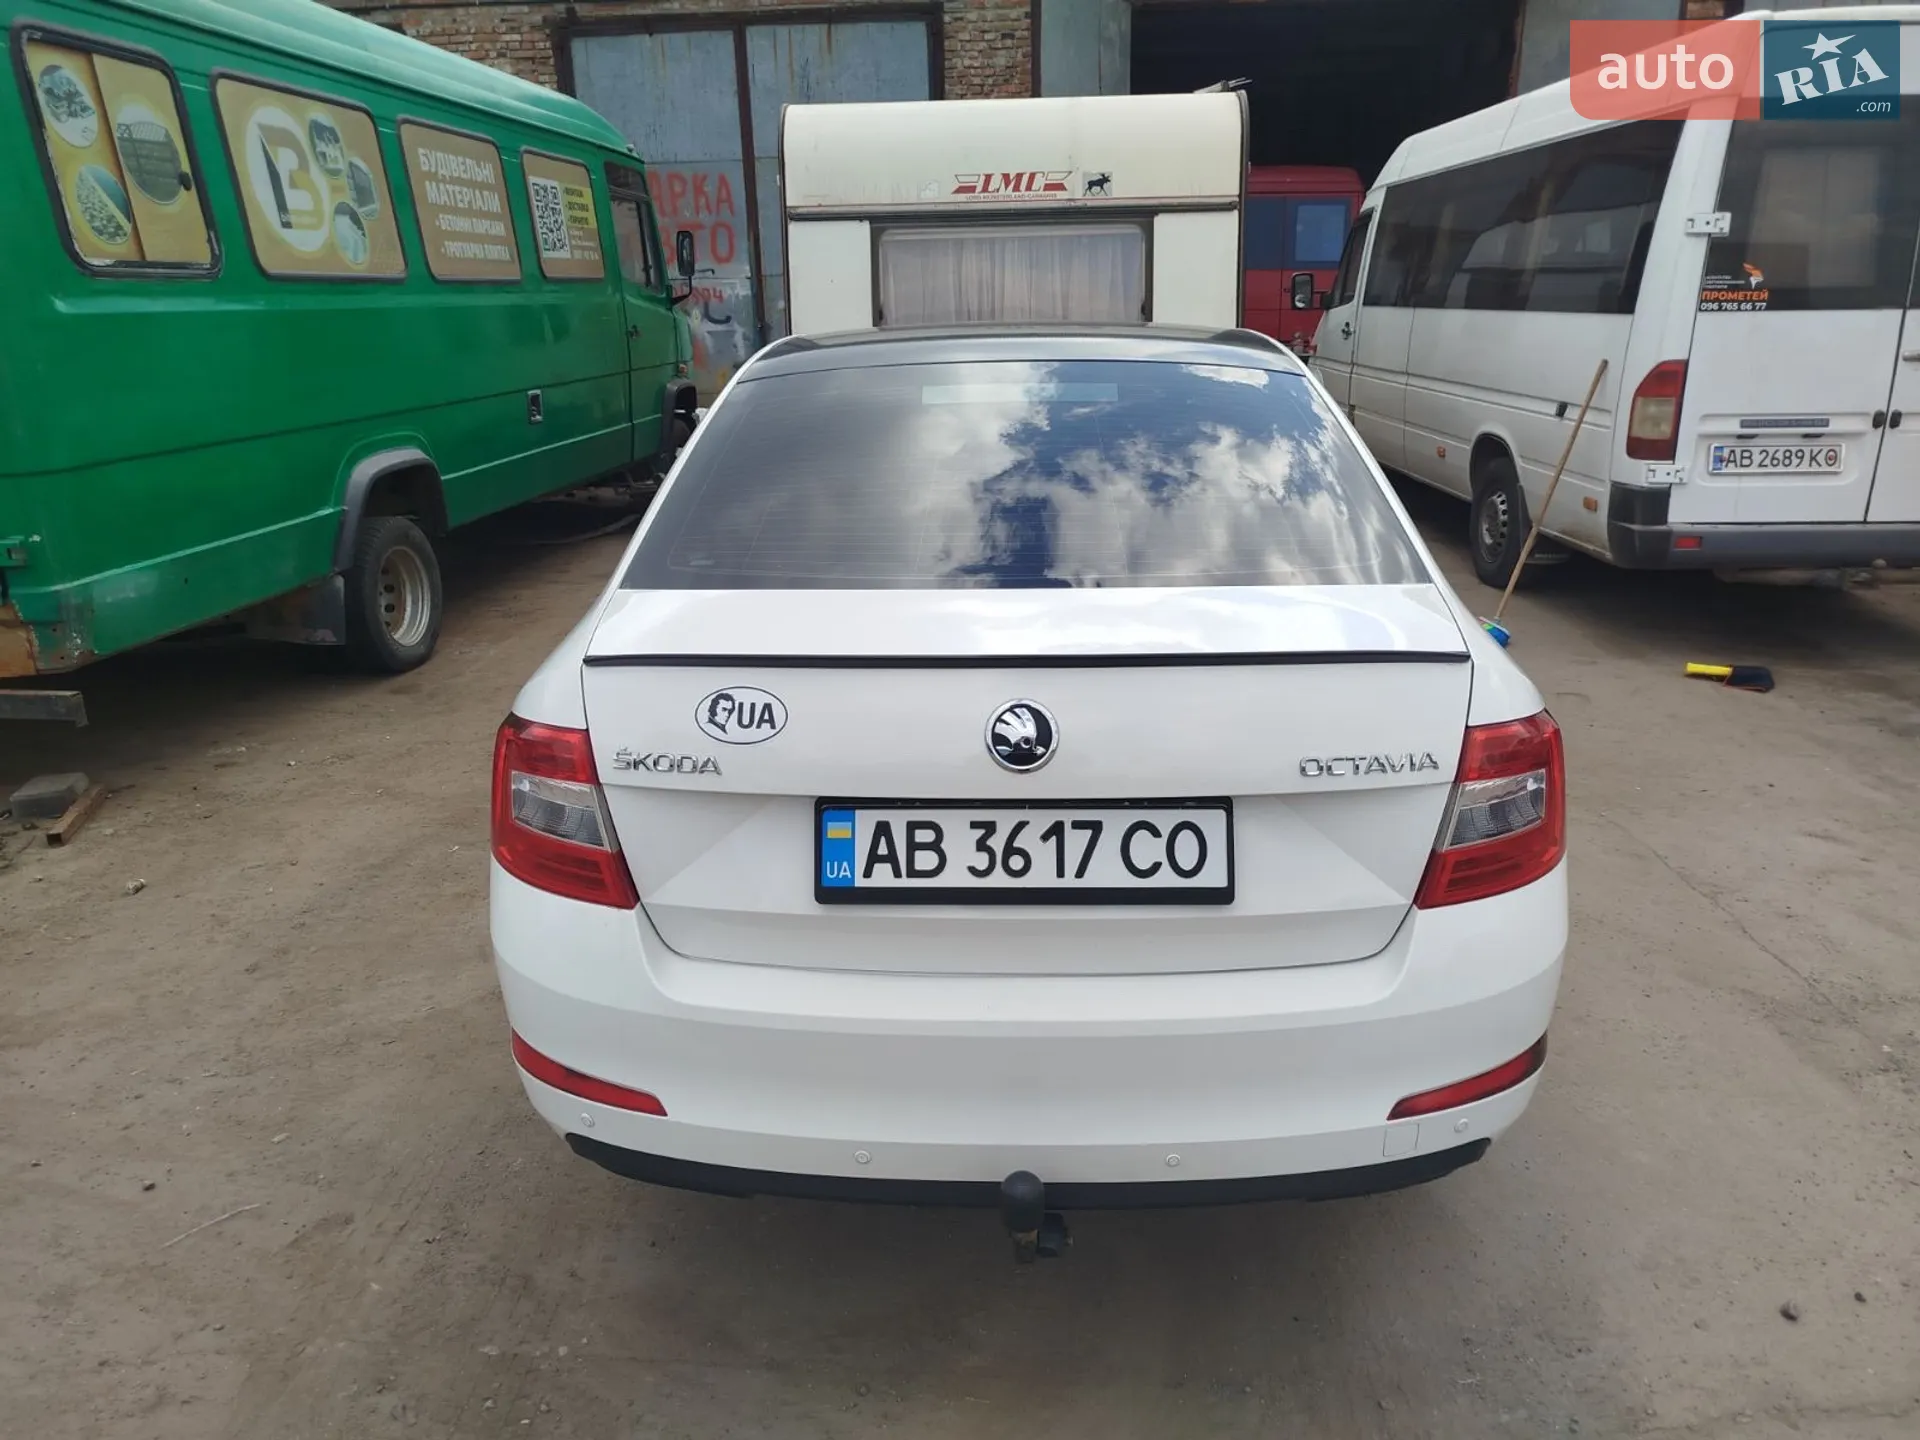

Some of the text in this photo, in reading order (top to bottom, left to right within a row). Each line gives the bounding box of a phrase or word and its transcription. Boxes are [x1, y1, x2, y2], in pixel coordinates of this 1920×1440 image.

[417, 147, 496, 184] БУДІВЕЛЬНІ
[979, 171, 1045, 193] LMC
[425, 180, 502, 213] МАТЕРІАЛИ
[1700, 302, 1719, 311] 096
[1721, 302, 1739, 311] 765
[1754, 302, 1767, 311] 77
[1702, 288, 1769, 300] ПРОМЕТЕЙ
[1724, 449, 1753, 468] AB
[1758, 449, 1806, 468] 2689
[736, 701, 777, 730] UA
[612, 747, 723, 776] ŠKODA
[1299, 752, 1440, 777] OCTAVIA
[862, 820, 1208, 879] AB 3617 CO
[826, 861, 852, 879] UA
